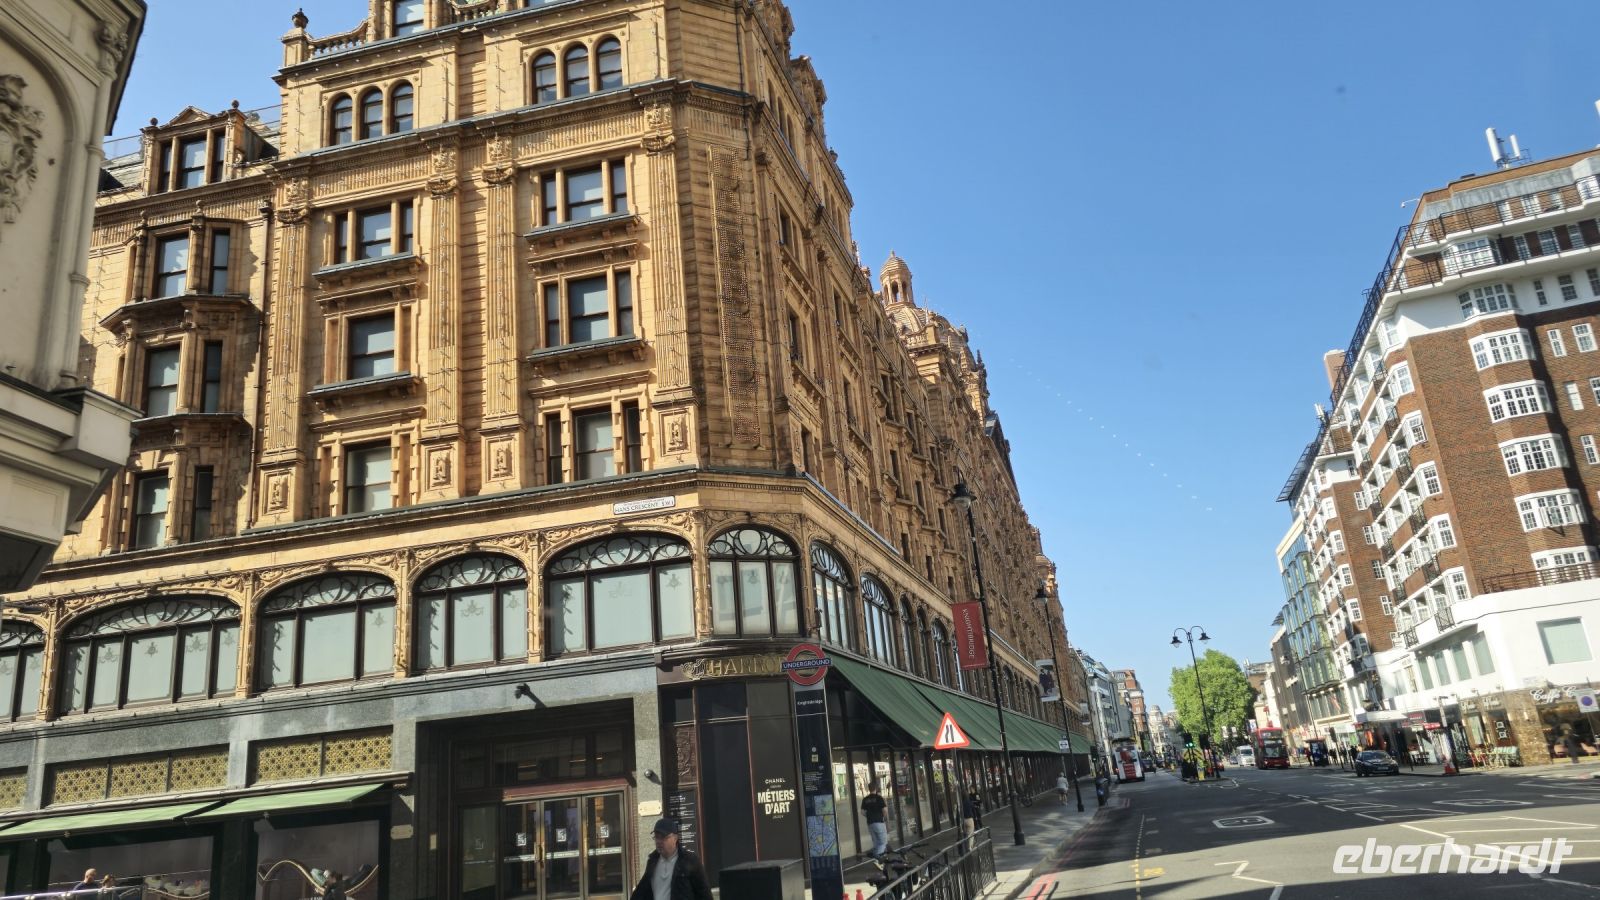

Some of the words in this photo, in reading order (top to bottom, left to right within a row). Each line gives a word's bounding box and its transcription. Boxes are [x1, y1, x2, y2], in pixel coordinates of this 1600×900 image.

[630, 502, 659, 510] CRESCENT
[783, 659, 830, 669] UNDERGROUND
[757, 788, 796, 804] MÉTIERS
[764, 801, 791, 815] D'ART
